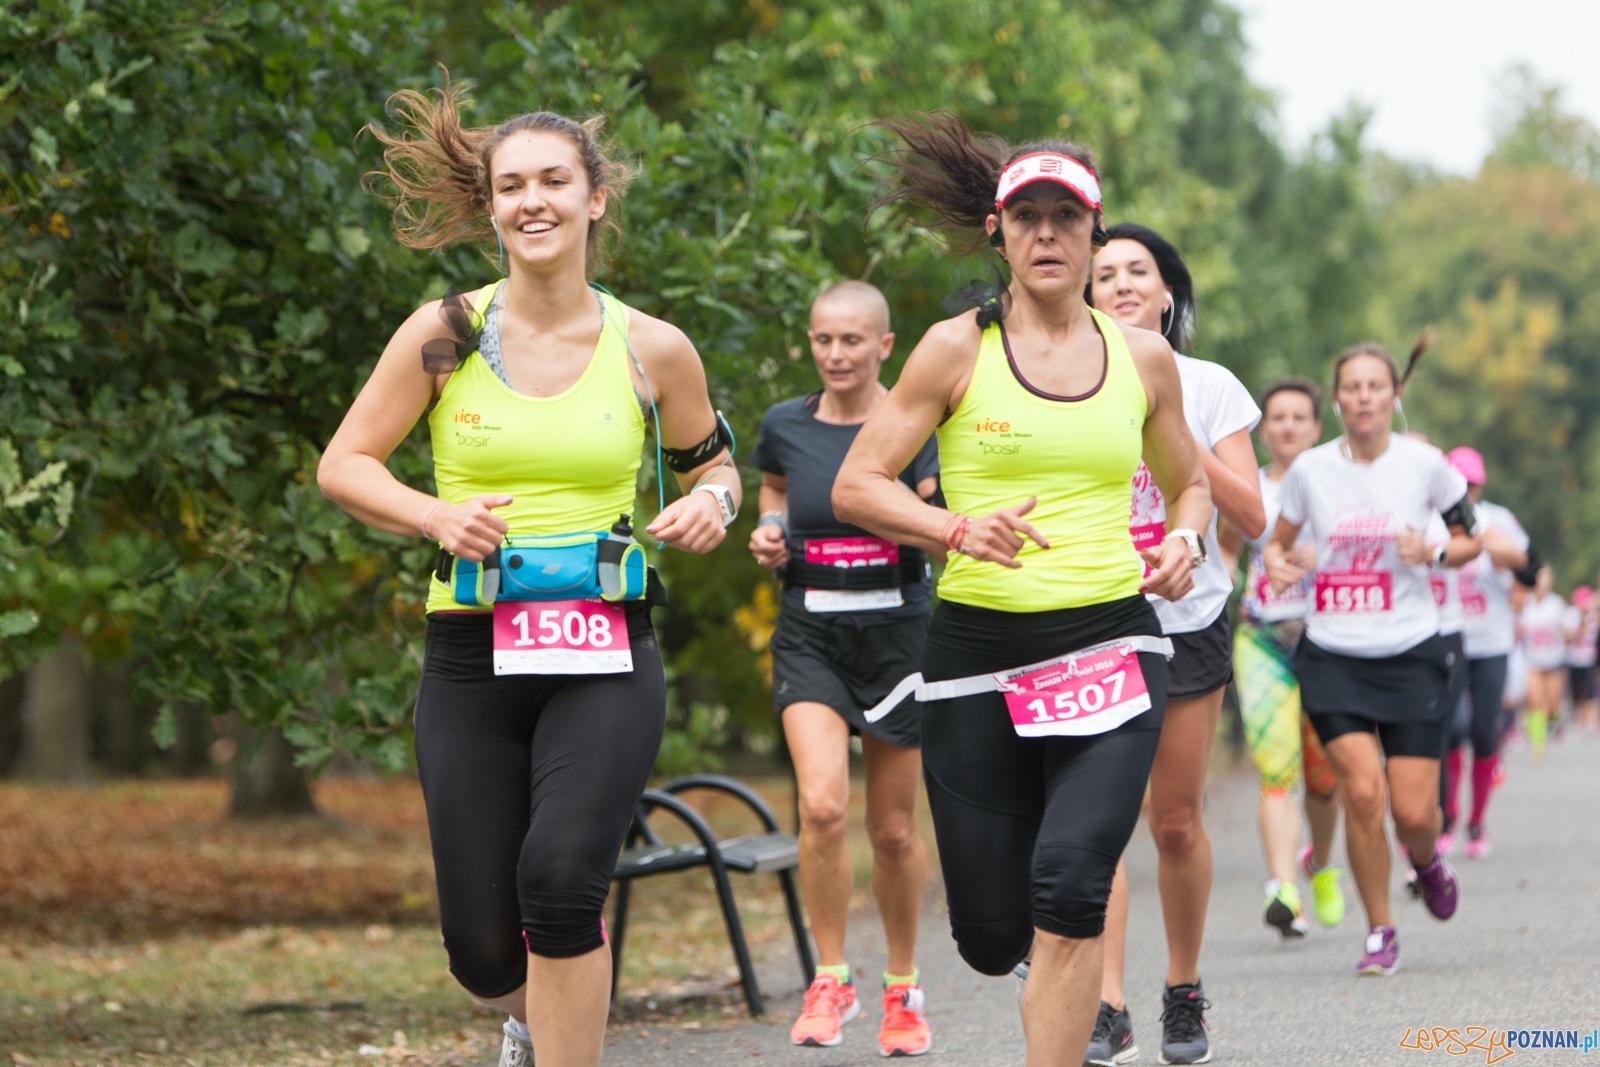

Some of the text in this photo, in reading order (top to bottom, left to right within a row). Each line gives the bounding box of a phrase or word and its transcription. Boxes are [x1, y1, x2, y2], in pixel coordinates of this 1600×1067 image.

[511, 609, 613, 647] 1508
[1094, 659, 1115, 672] 2016
[1026, 670, 1127, 723] 1507
